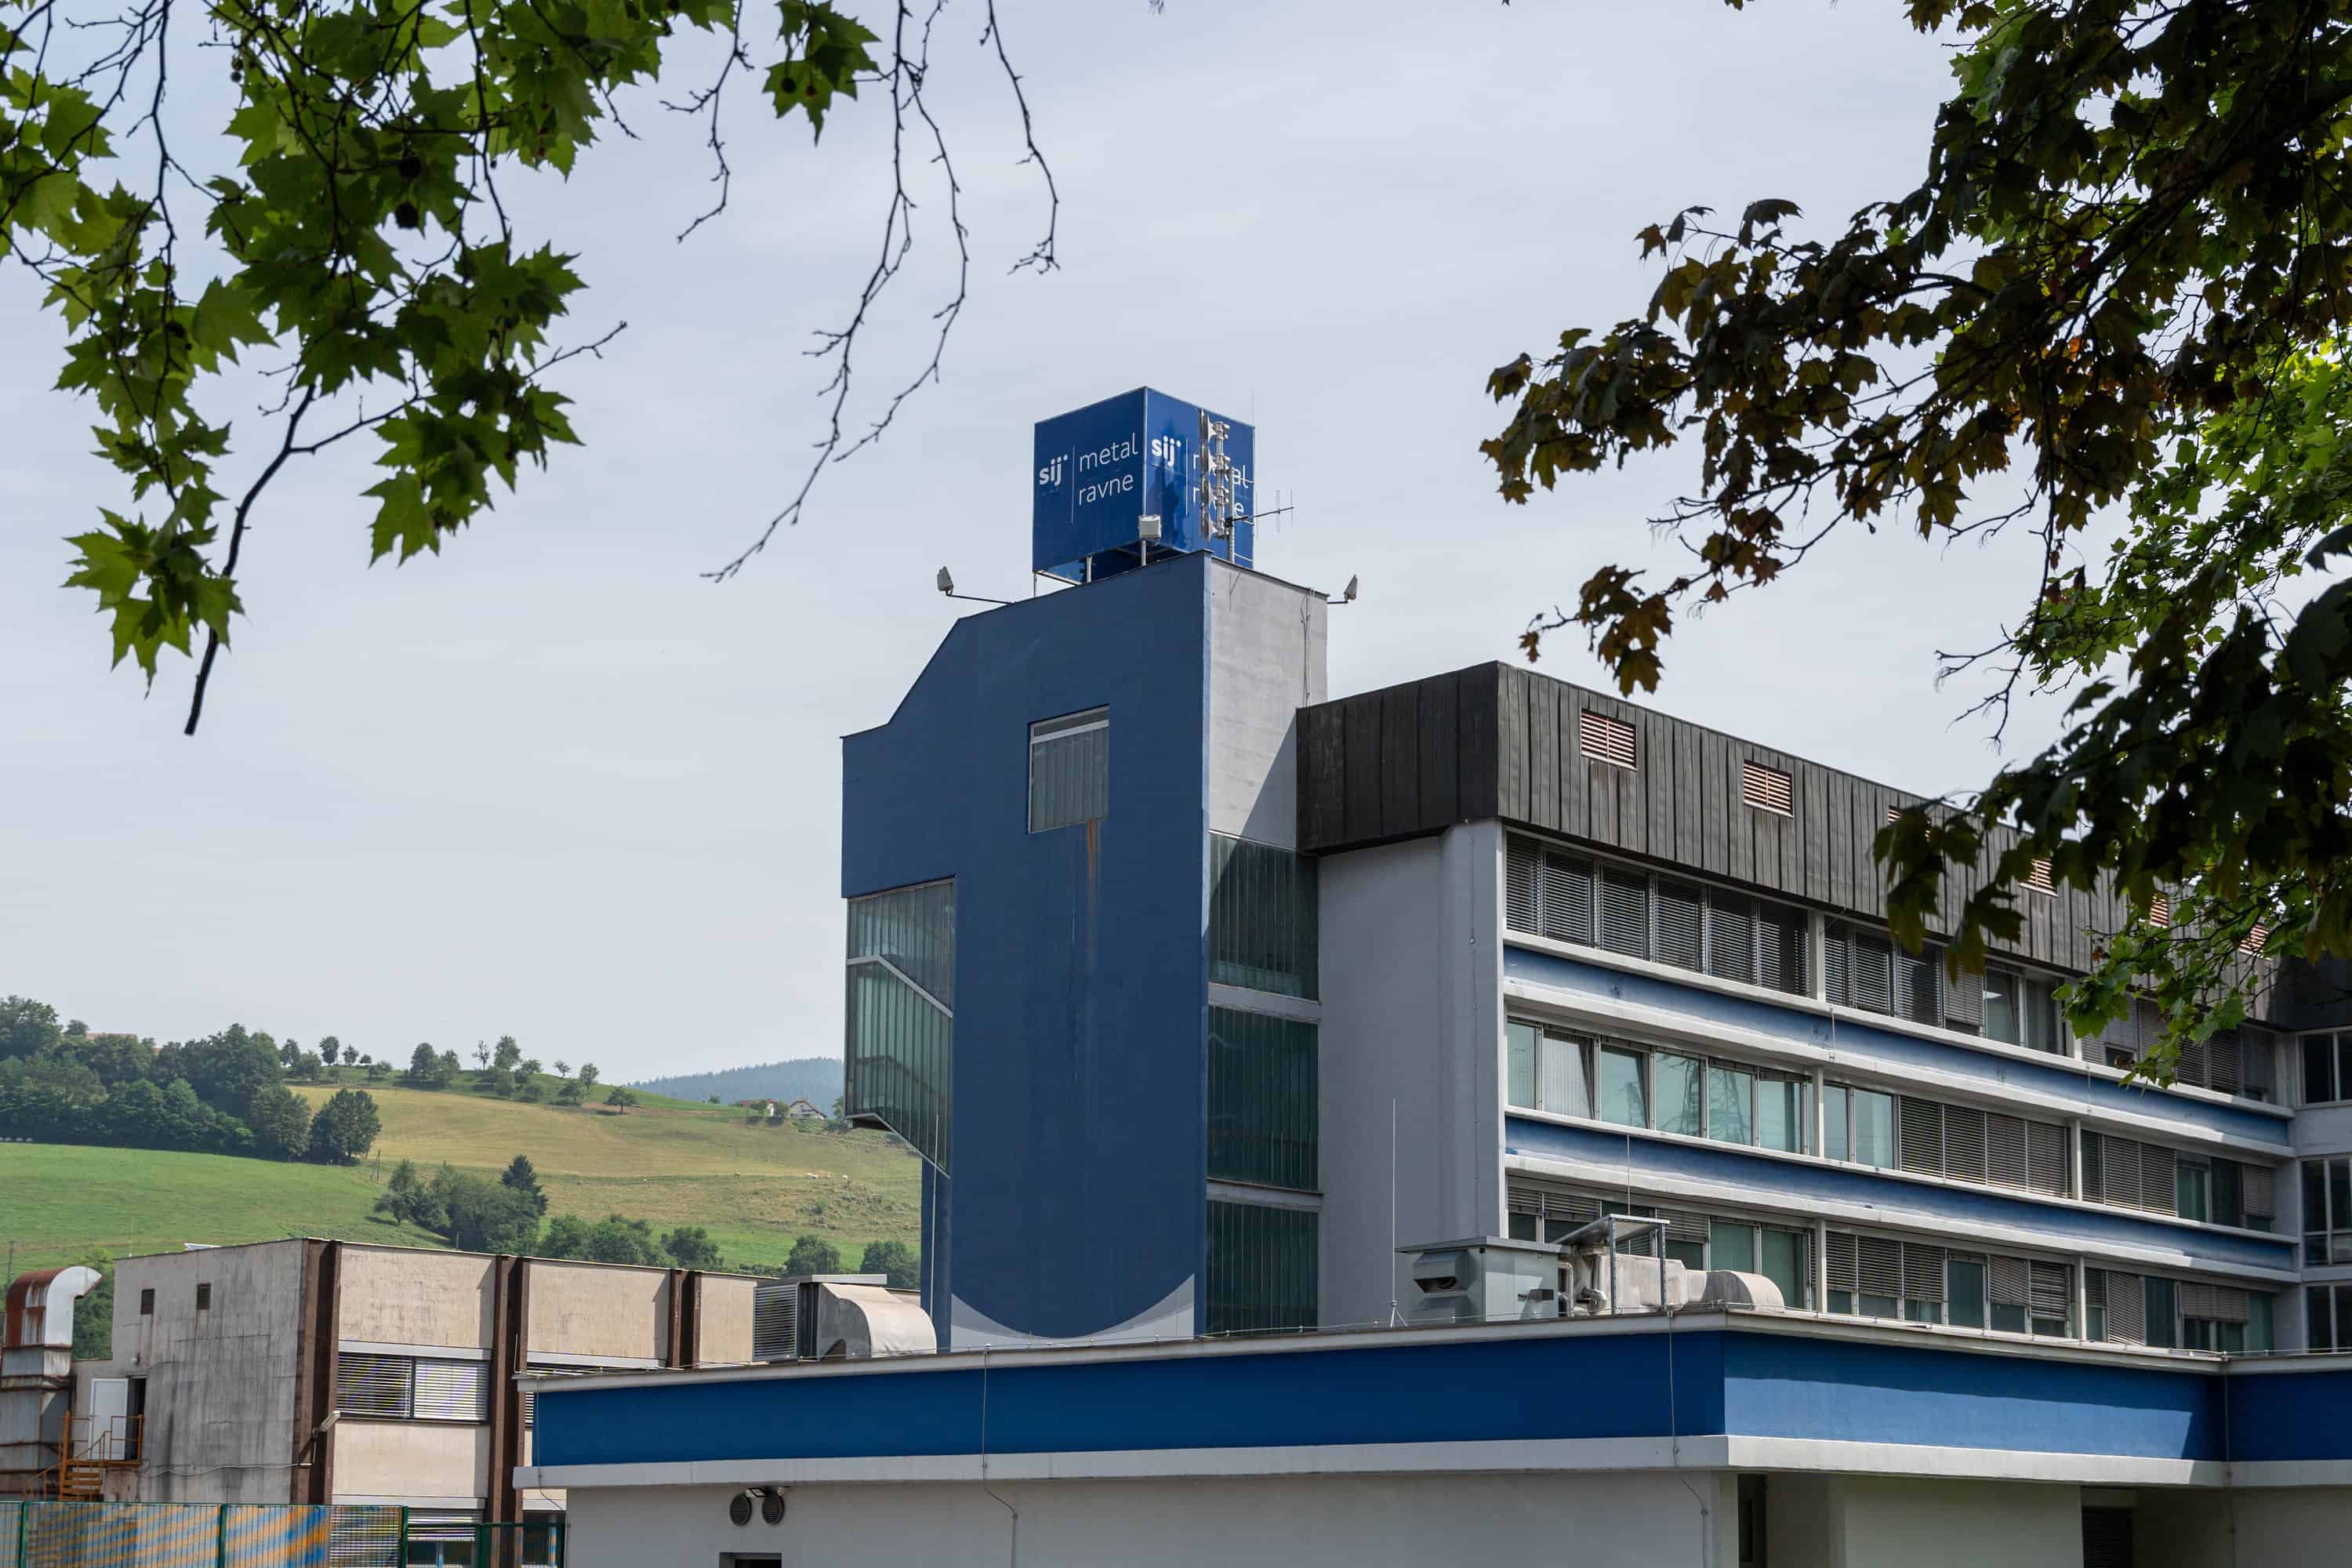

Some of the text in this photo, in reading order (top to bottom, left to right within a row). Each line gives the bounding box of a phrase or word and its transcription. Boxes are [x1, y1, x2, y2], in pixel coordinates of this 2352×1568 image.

[1079, 432, 1139, 472] metal
[1151, 435, 1179, 467] sij
[1039, 455, 1066, 486] sij
[1079, 474, 1134, 506] ravne
